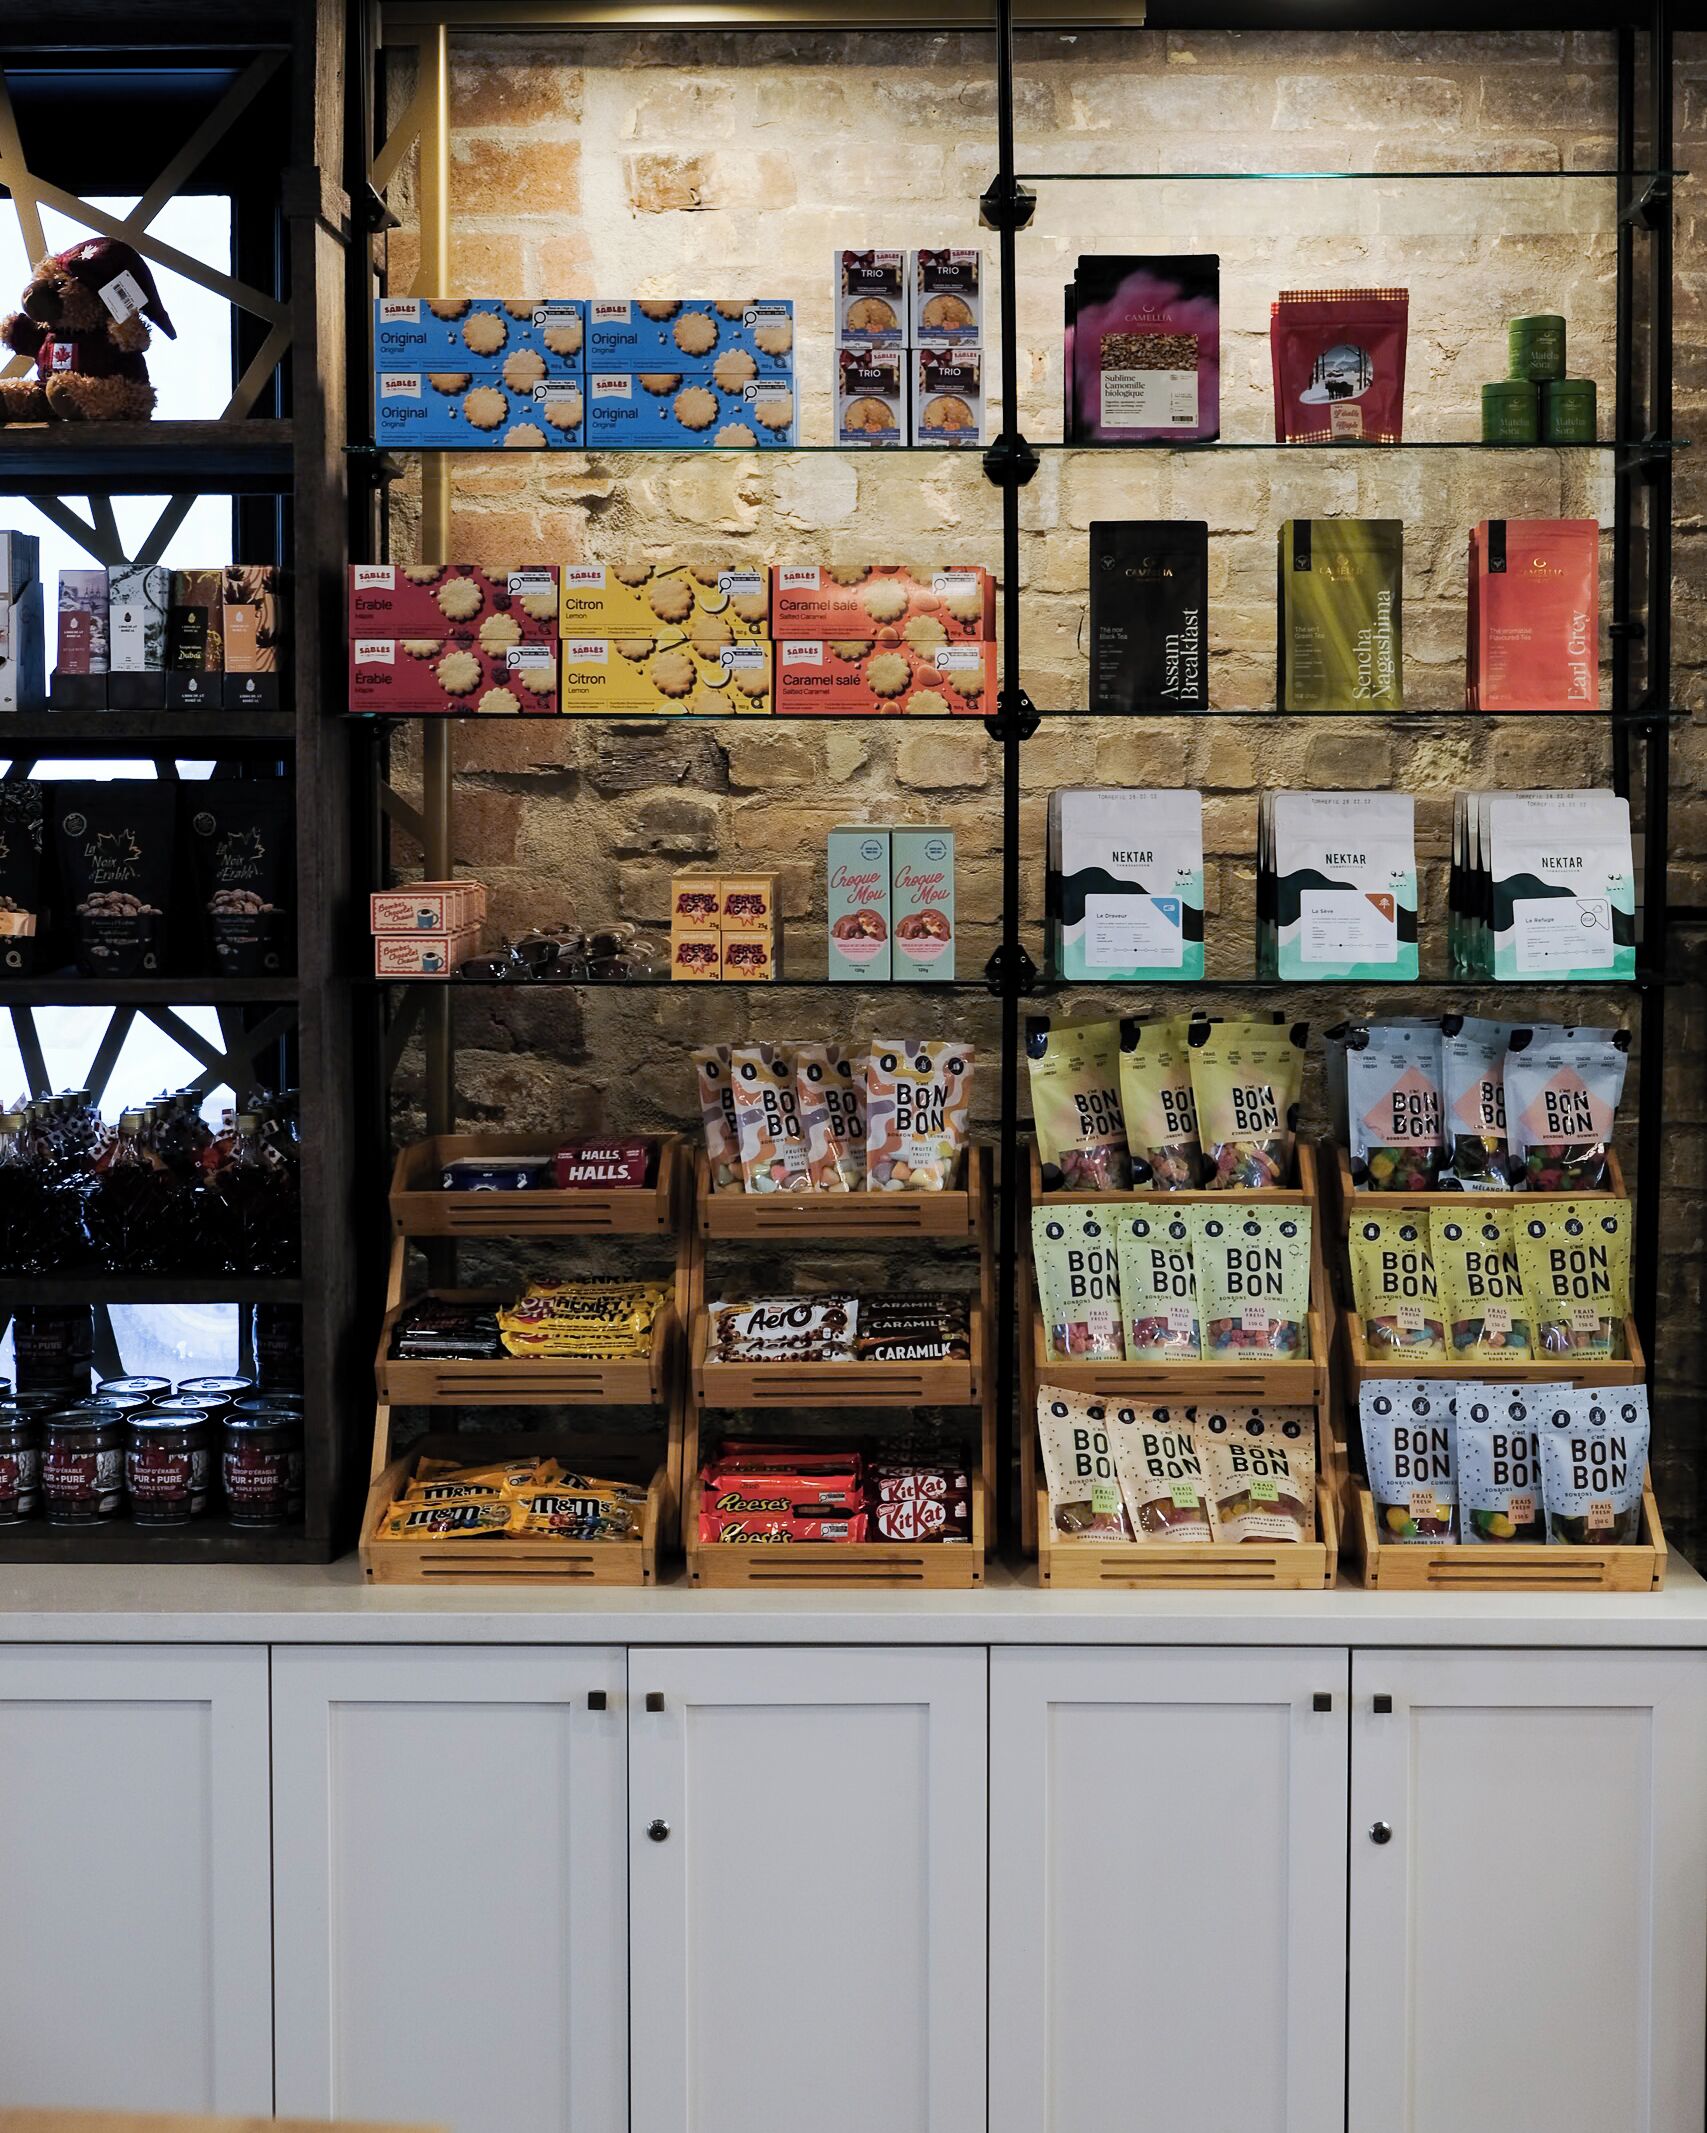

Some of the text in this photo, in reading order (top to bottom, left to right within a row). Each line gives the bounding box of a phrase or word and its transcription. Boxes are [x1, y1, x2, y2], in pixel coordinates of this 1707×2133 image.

[861, 269, 884, 278] TRIO
[937, 266, 960, 275] TRIO
[1125, 314, 1173, 322] CAMELLIA
[381, 333, 427, 346] Original
[591, 333, 638, 346] Original
[858, 369, 881, 378] TRIO
[938, 368, 961, 376] TRIO
[1105, 374, 1136, 382] Sublime
[1105, 389, 1144, 398] biologique
[381, 406, 428, 421] Original
[592, 407, 638, 422] Original
[355, 596, 393, 611] Érable
[565, 598, 604, 610] Citron
[779, 599, 858, 611] Caramel salé
[1180, 608, 1199, 700] Breakfast
[1371, 589, 1396, 700] Nagashima
[1567, 610, 1590, 700] Earl Grey
[1160, 634, 1179, 700] Assam
[1352, 628, 1372, 700] Sencha
[355, 670, 393, 685] Érable
[568, 673, 606, 685] Citron
[782, 673, 861, 686] Caramel salé
[92, 855, 117, 868] Noix
[1112, 851, 1154, 863] NEKTAR
[1325, 853, 1367, 865] NEKTAR
[1541, 857, 1583, 868] NEKTAR
[830, 865, 881, 893] Croque
[894, 865, 945, 893] Croque
[847, 885, 887, 904] Mou
[911, 885, 951, 904] Mou
[897, 1083, 949, 1109] BON
[1073, 1088, 1119, 1114] BON
[1232, 1086, 1275, 1111] BON
[1392, 1091, 1438, 1116] BON
[1545, 1090, 1590, 1114] BON
[896, 1107, 945, 1135] BON
[1080, 1110, 1125, 1136] BON
[1235, 1107, 1279, 1132] BON
[1393, 1113, 1440, 1138] BON
[1547, 1112, 1594, 1136] BON
[568, 1164, 632, 1181] HALLS.
[1068, 1248, 1119, 1275] BON
[1226, 1248, 1283, 1273] BON
[1382, 1251, 1435, 1275] BON
[1466, 1251, 1519, 1276] BON
[1550, 1245, 1609, 1274] BON
[1070, 1273, 1121, 1300] BON
[1227, 1271, 1284, 1297] BON
[1383, 1272, 1438, 1298] BON
[1468, 1273, 1524, 1298] BON
[1552, 1270, 1611, 1299] BON
[871, 1301, 946, 1309] CARAMILK
[872, 1319, 948, 1329] CARAMILK
[875, 1342, 951, 1361] CARAMILK
[1073, 1428, 1109, 1455] BO
[1142, 1433, 1195, 1459] BON
[1229, 1444, 1287, 1460] BON
[1394, 1427, 1449, 1456] BON
[1571, 1436, 1627, 1466] BON
[1147, 1456, 1202, 1479] BON
[1232, 1456, 1290, 1477] BON
[1395, 1454, 1450, 1482] BON
[1573, 1463, 1627, 1493] BON
[60, 1474, 86, 1484] PURE
[133, 1474, 182, 1484] PUR PURE
[230, 1475, 279, 1485] PUR PURE
[530, 1496, 611, 1519] m&m's
[716, 1491, 791, 1513] Reese's
[407, 1505, 491, 1527] m&m's
